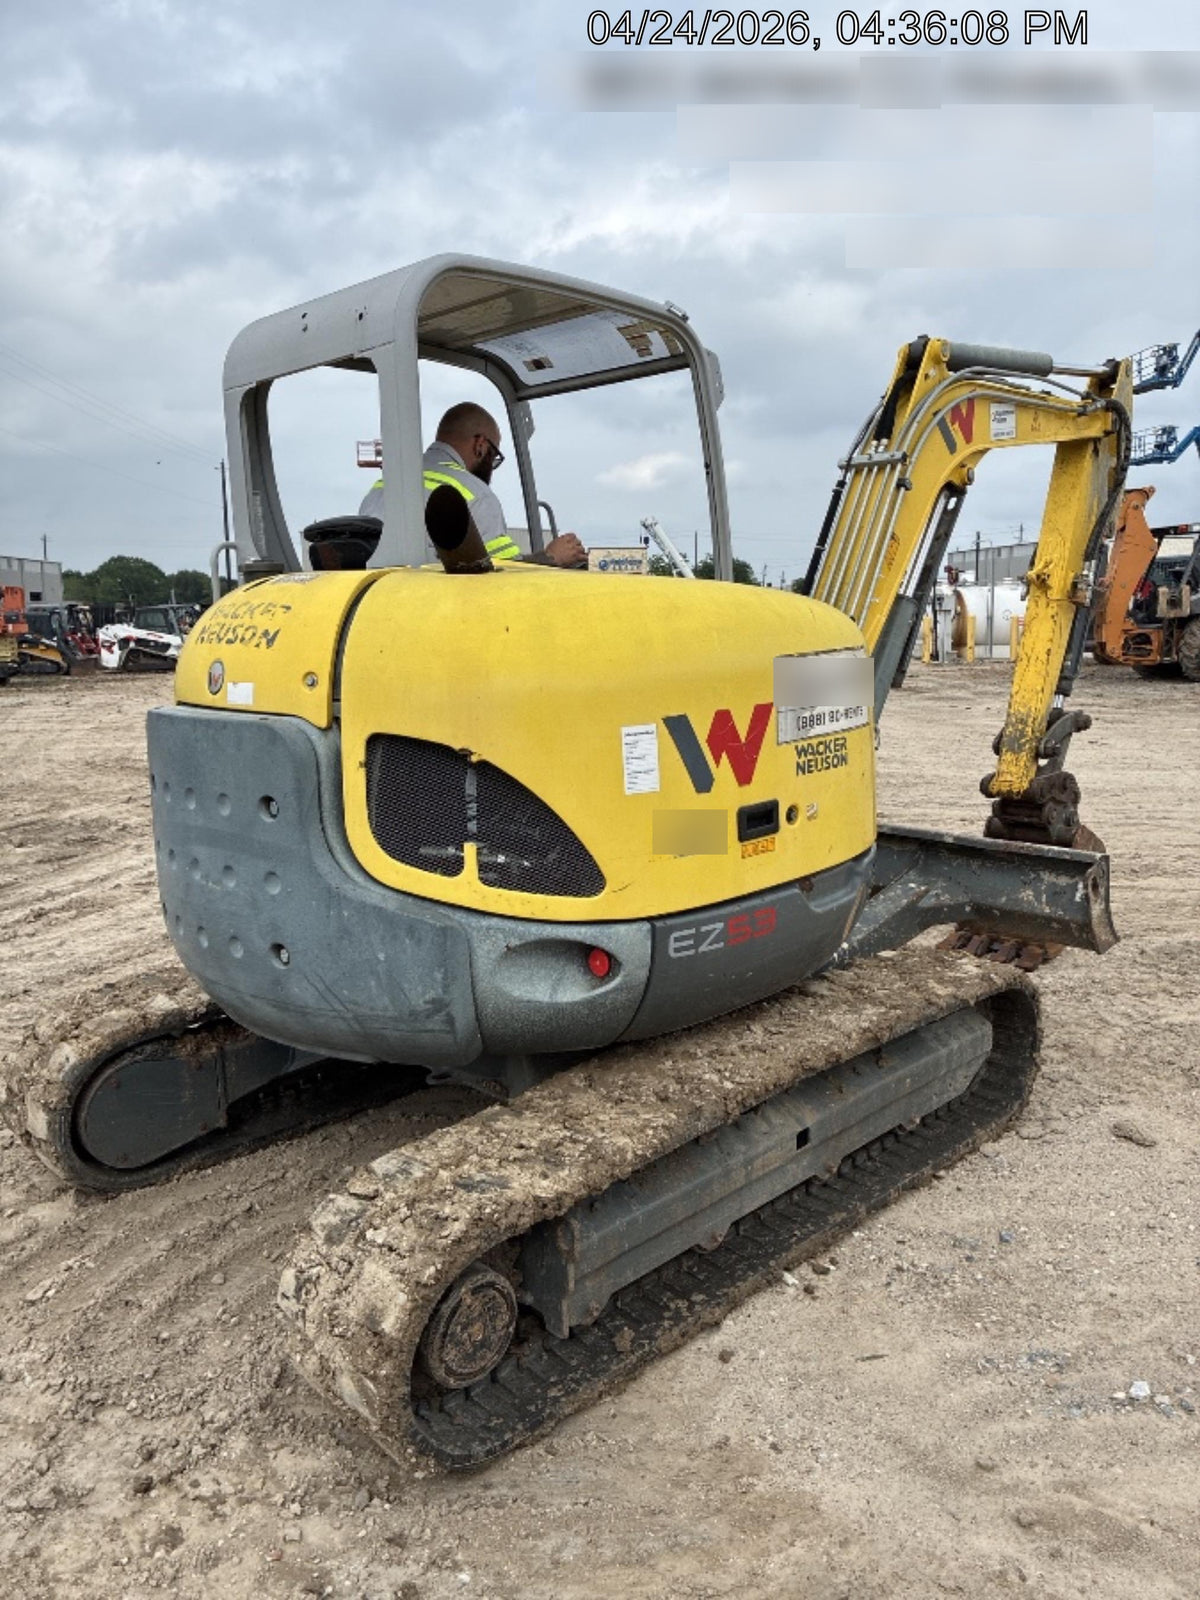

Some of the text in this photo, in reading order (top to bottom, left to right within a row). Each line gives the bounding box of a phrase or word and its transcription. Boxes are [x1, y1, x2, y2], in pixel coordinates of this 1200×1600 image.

[794, 737, 847, 759] WACKER
[796, 753, 848, 776] NEUSON
[668, 906, 777, 958] EZ53
